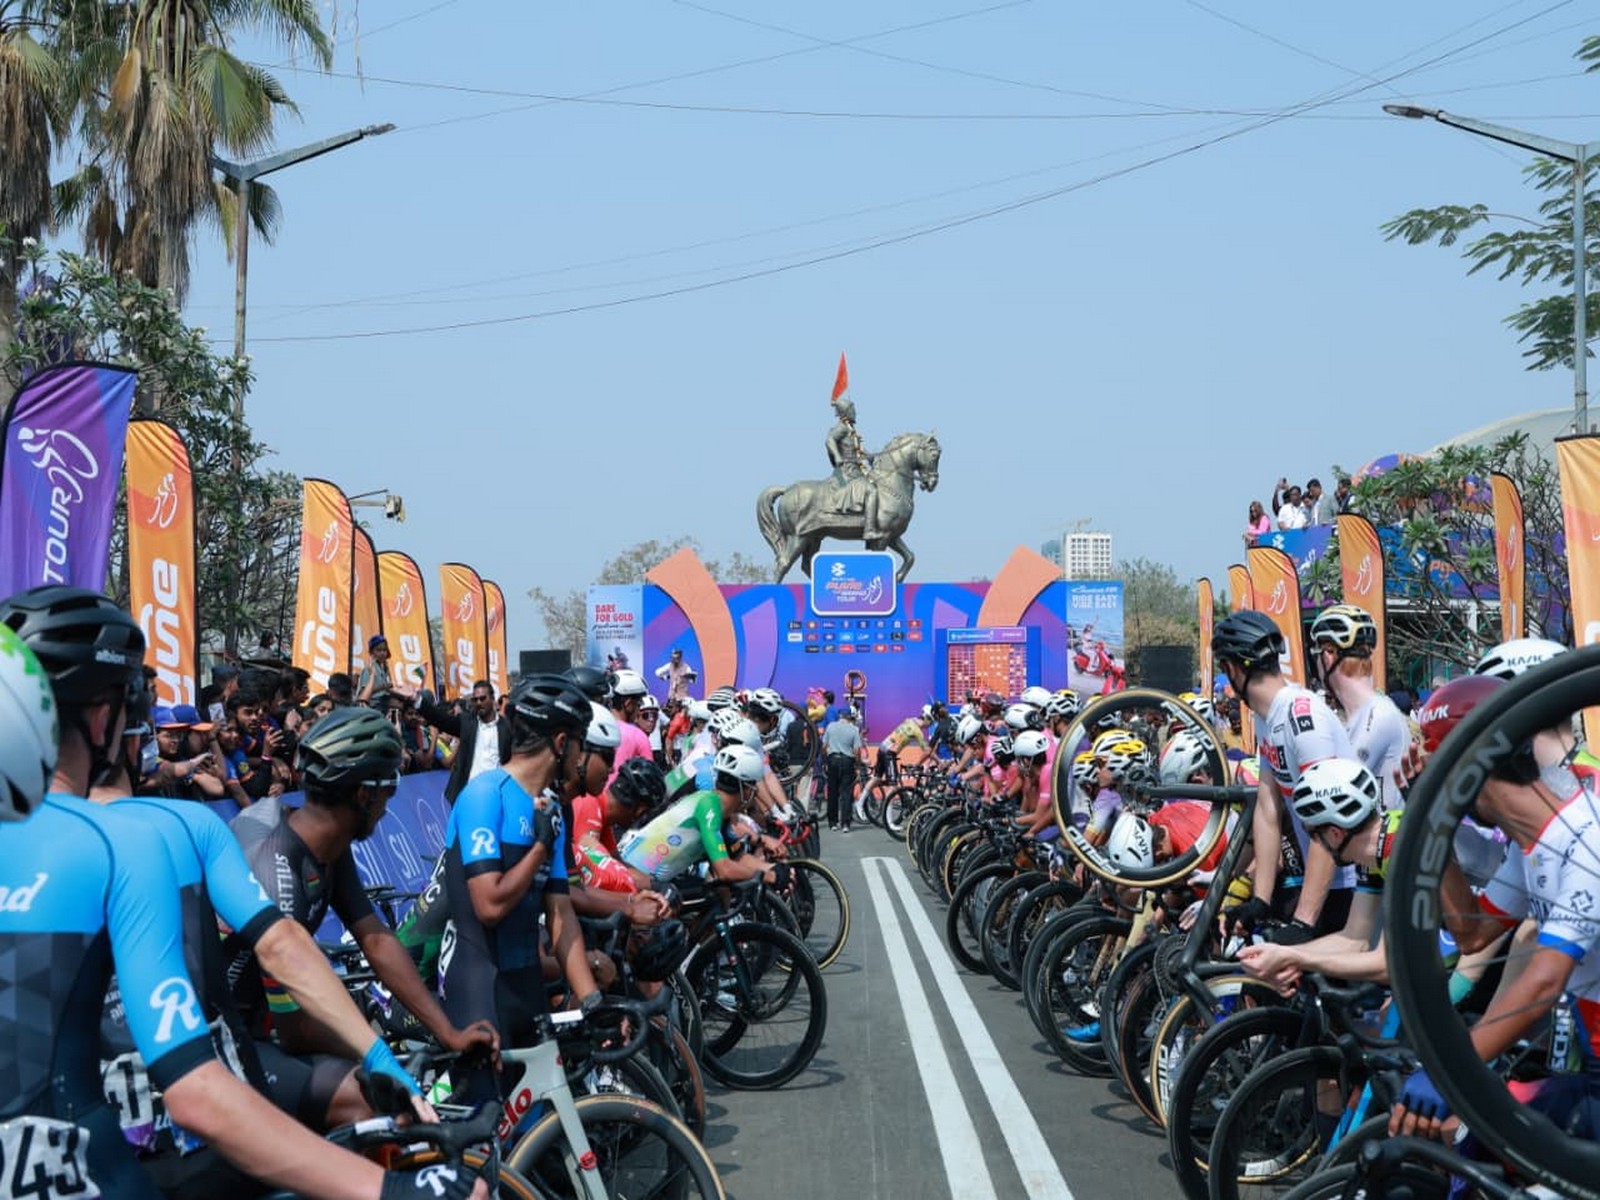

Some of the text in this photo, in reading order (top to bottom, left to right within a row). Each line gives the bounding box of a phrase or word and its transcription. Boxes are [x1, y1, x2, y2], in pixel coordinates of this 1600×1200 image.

[43, 486, 71, 584] TOUR
[595, 604, 616, 613] DARE
[595, 613, 634, 622] FOR GOLD
[1507, 655, 1543, 666] KASK
[1315, 786, 1343, 799] KASK
[470, 827, 496, 857] R
[1411, 731, 1513, 931] PISTON
[150, 976, 200, 1043] R
[0, 1124, 87, 1200] 43
[415, 1164, 458, 1197] R
